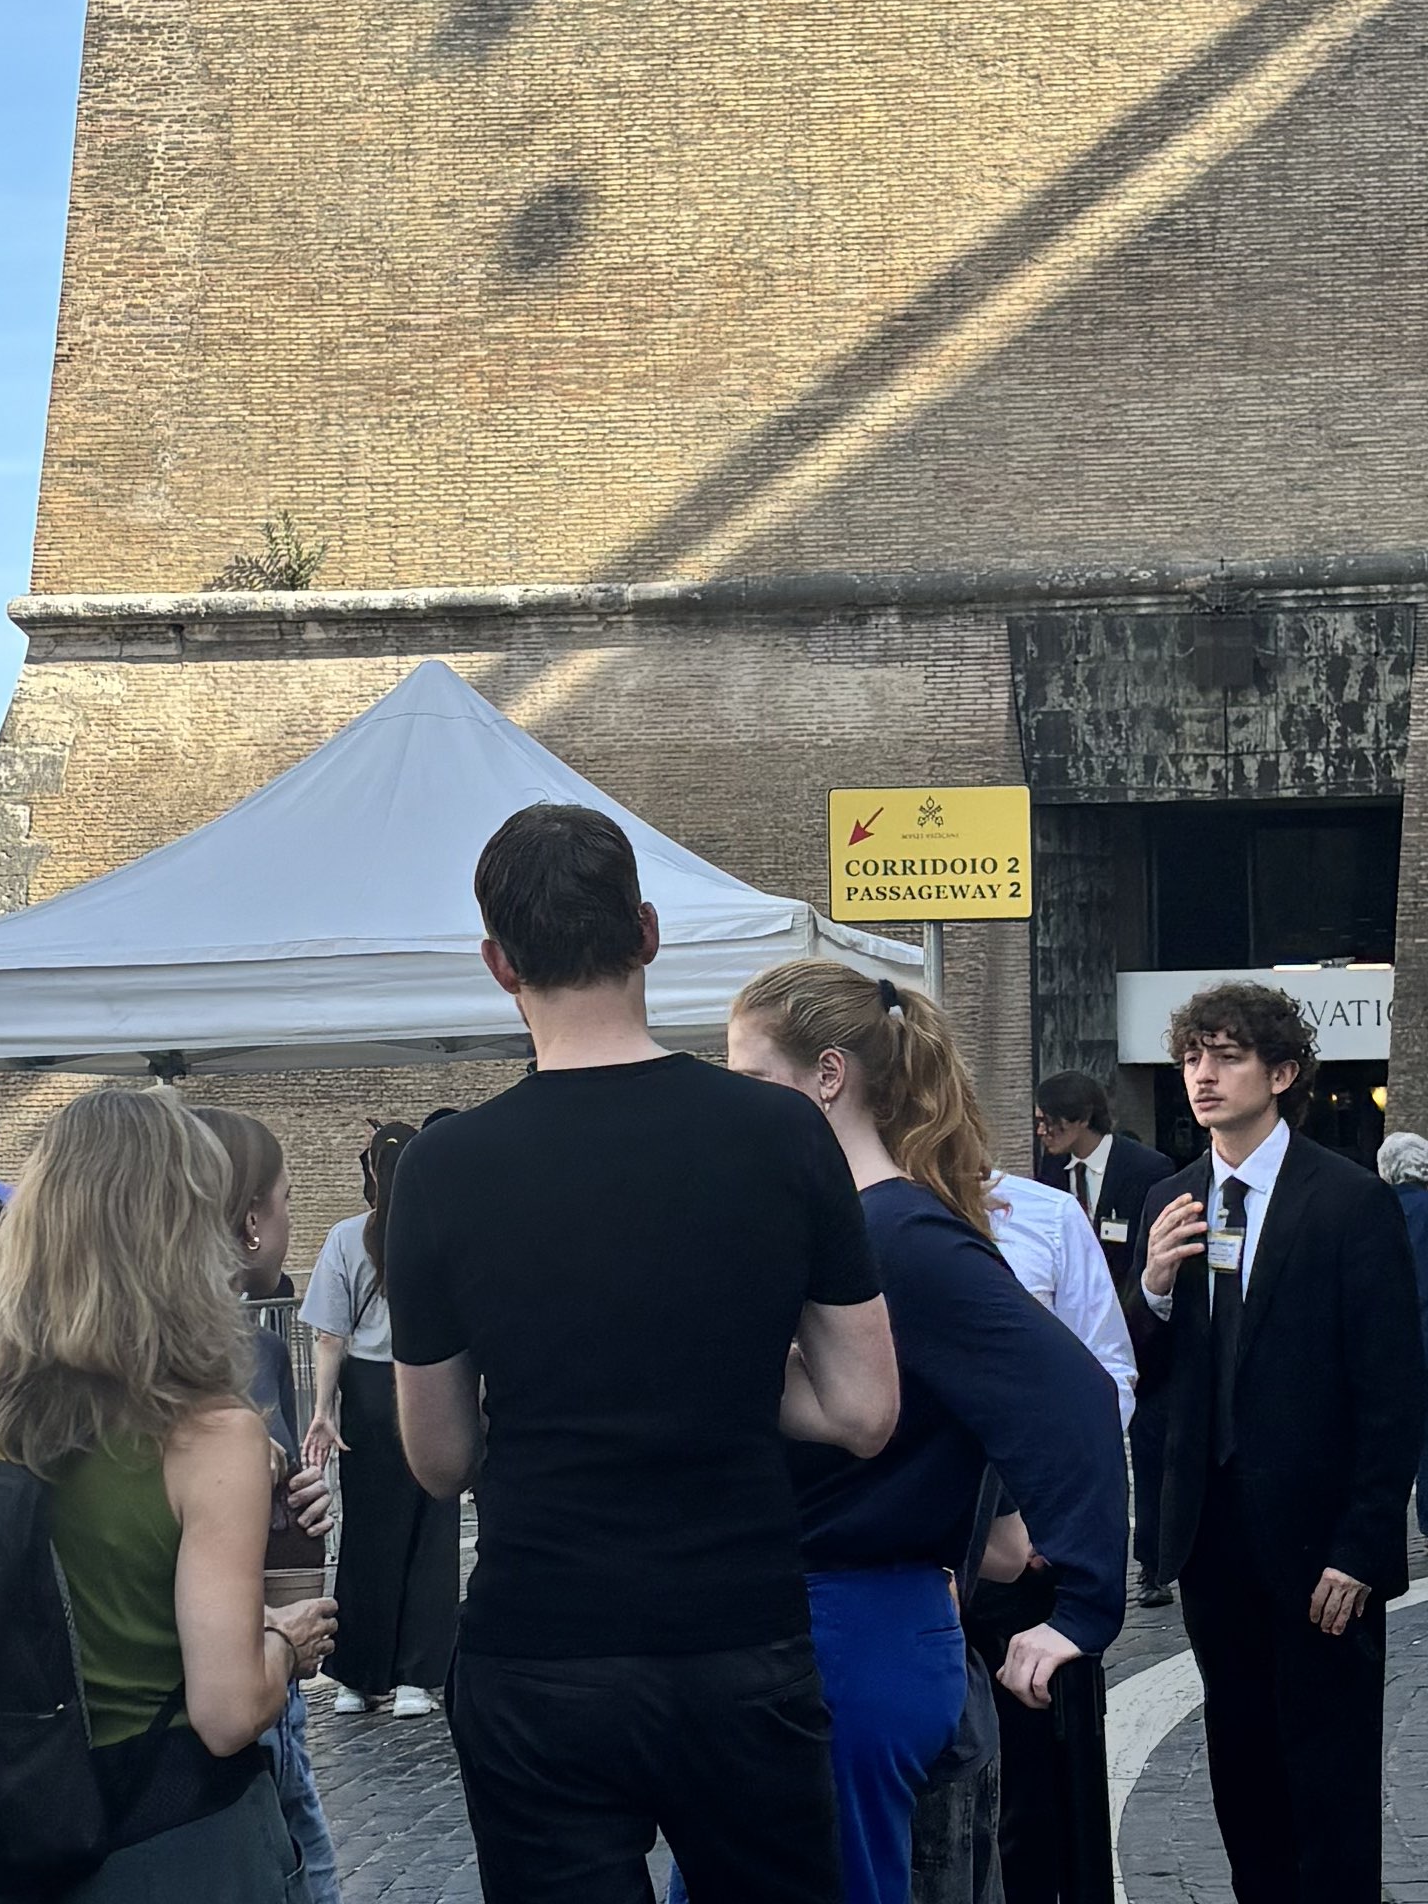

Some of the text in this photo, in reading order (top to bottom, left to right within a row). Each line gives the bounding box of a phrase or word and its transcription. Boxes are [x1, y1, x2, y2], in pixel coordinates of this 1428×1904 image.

[845, 857, 1020, 877] CORRIDOIO 2
[846, 881, 1022, 902] PASSAGEWAY 2
